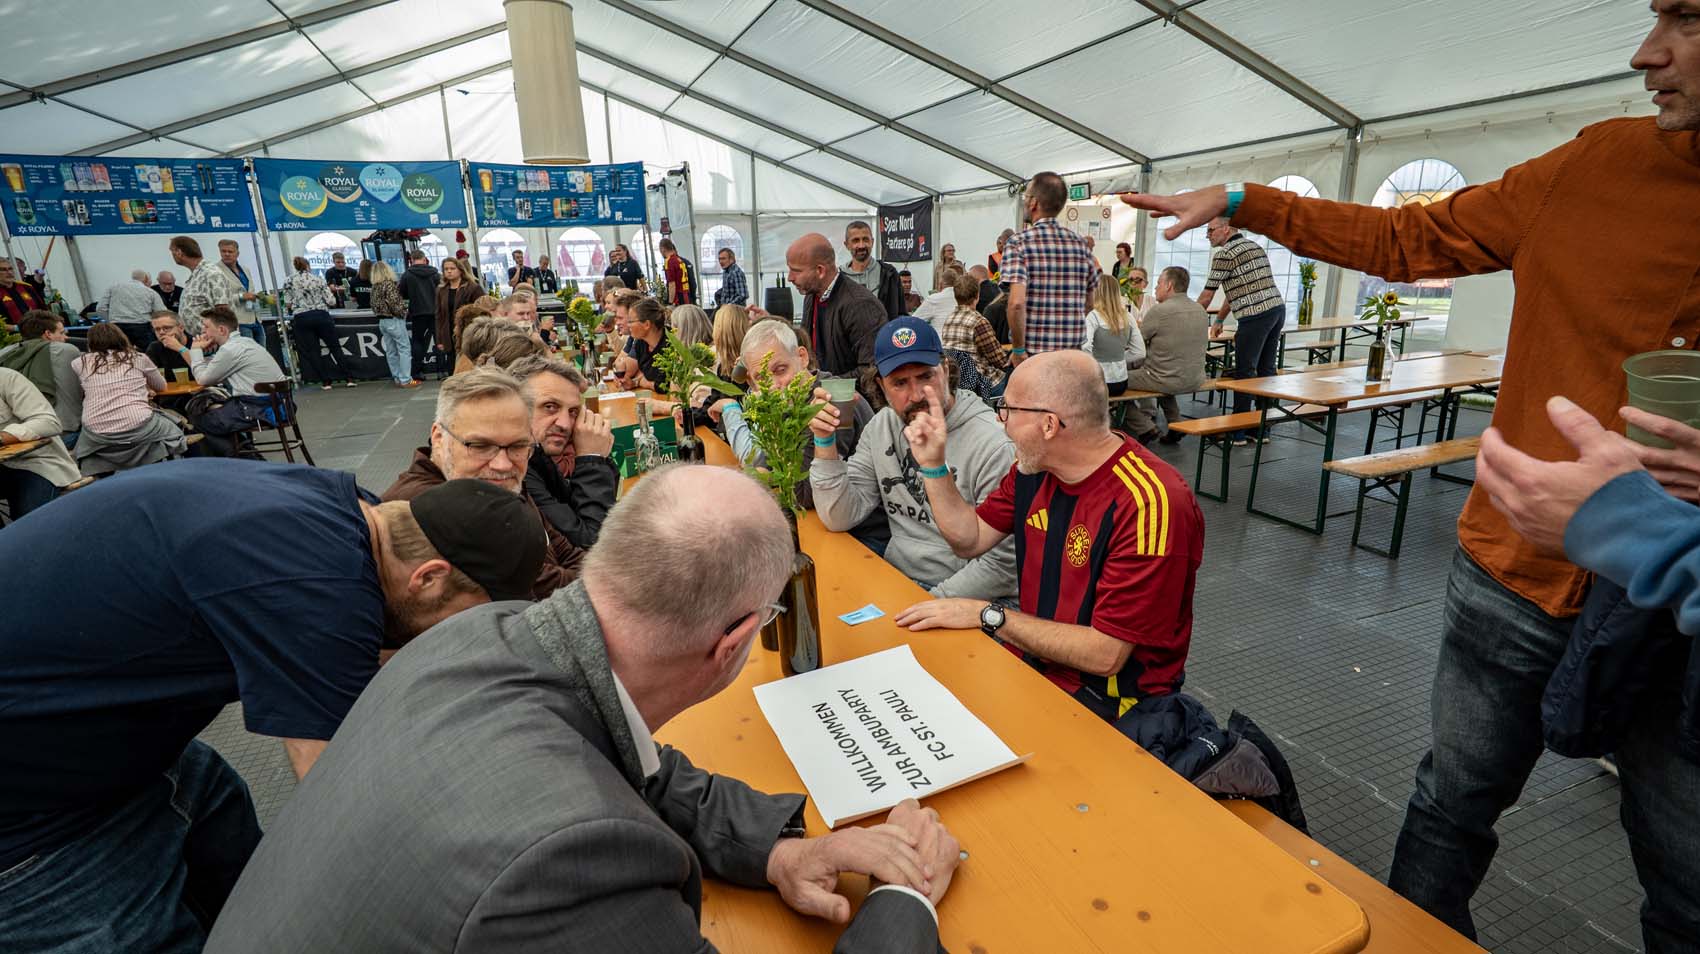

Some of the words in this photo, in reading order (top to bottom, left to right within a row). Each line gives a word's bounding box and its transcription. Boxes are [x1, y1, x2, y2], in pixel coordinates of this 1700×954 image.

[324, 177, 358, 186] ROYAL
[366, 178, 399, 187] ROYAL
[287, 192, 322, 201] ROYAL
[407, 188, 439, 197] ROYAL
[884, 216, 898, 235] Spar
[899, 213, 914, 231] Nord
[879, 689, 919, 722] PAULI
[837, 688, 905, 757] AMBUPARTY
[910, 721, 935, 741] ST.
[811, 702, 887, 793] WILLKOMMEN
[927, 741, 954, 761] FC
[895, 756, 932, 789] ZUR
